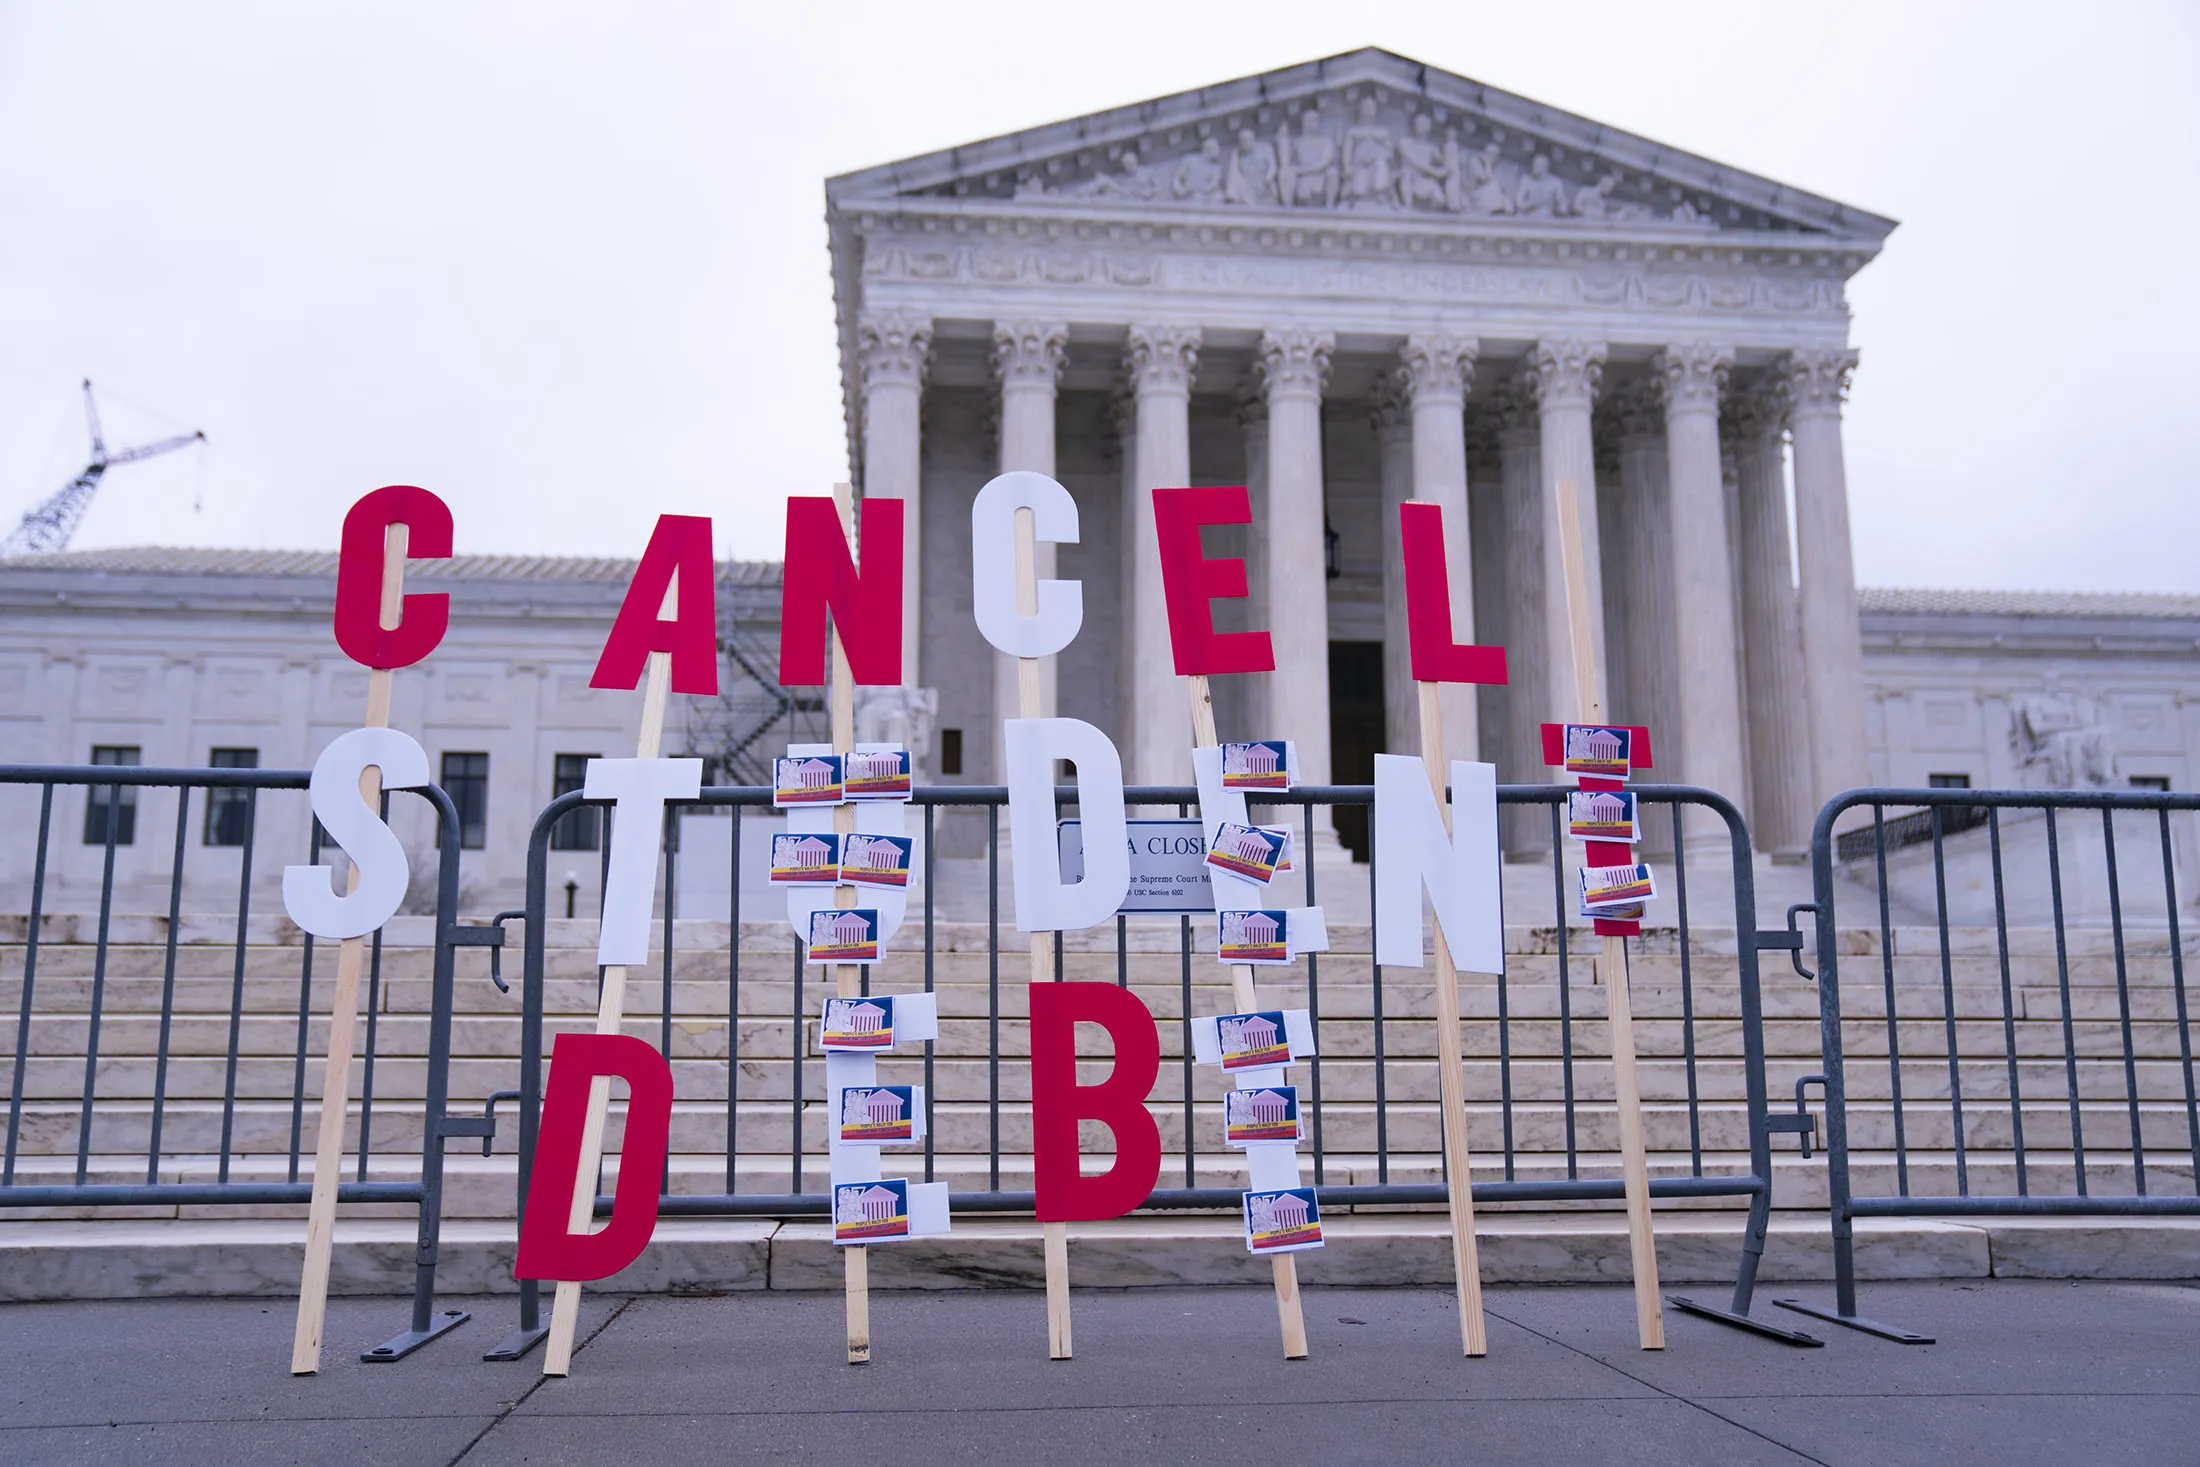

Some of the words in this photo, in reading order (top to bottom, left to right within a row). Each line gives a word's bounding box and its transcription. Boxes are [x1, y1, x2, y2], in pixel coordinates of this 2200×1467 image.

[333, 471, 1508, 695] CANCEL
[1140, 874, 1173, 884] Supreme
[1176, 874, 1198, 883] Court
